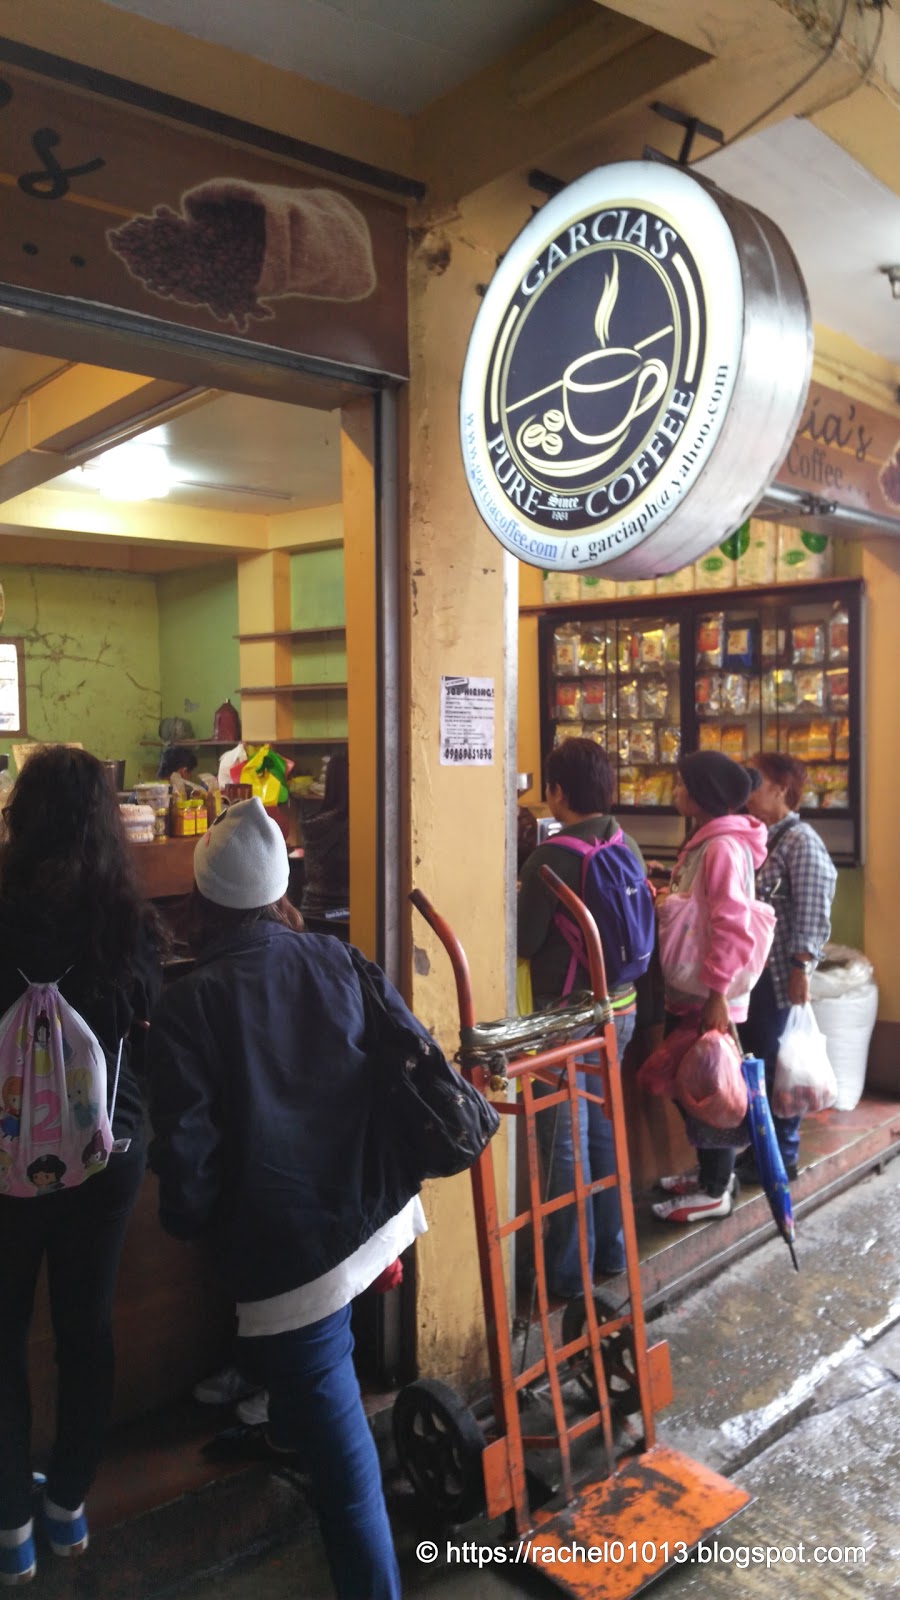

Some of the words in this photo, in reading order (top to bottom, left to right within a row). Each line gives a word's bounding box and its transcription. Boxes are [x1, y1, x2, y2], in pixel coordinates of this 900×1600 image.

[521, 210, 677, 296] GARCIA'S
[465, 412, 557, 560] www.garciacoffee.com
[571, 364, 728, 563] e_garciaph@yahoo.com
[487, 433, 543, 516] PURE
[585, 388, 694, 517] COFFEE
[798, 398, 872, 462] ia's
[547, 493, 580, 508] Since
[32, 1088, 62, 1142] 2
